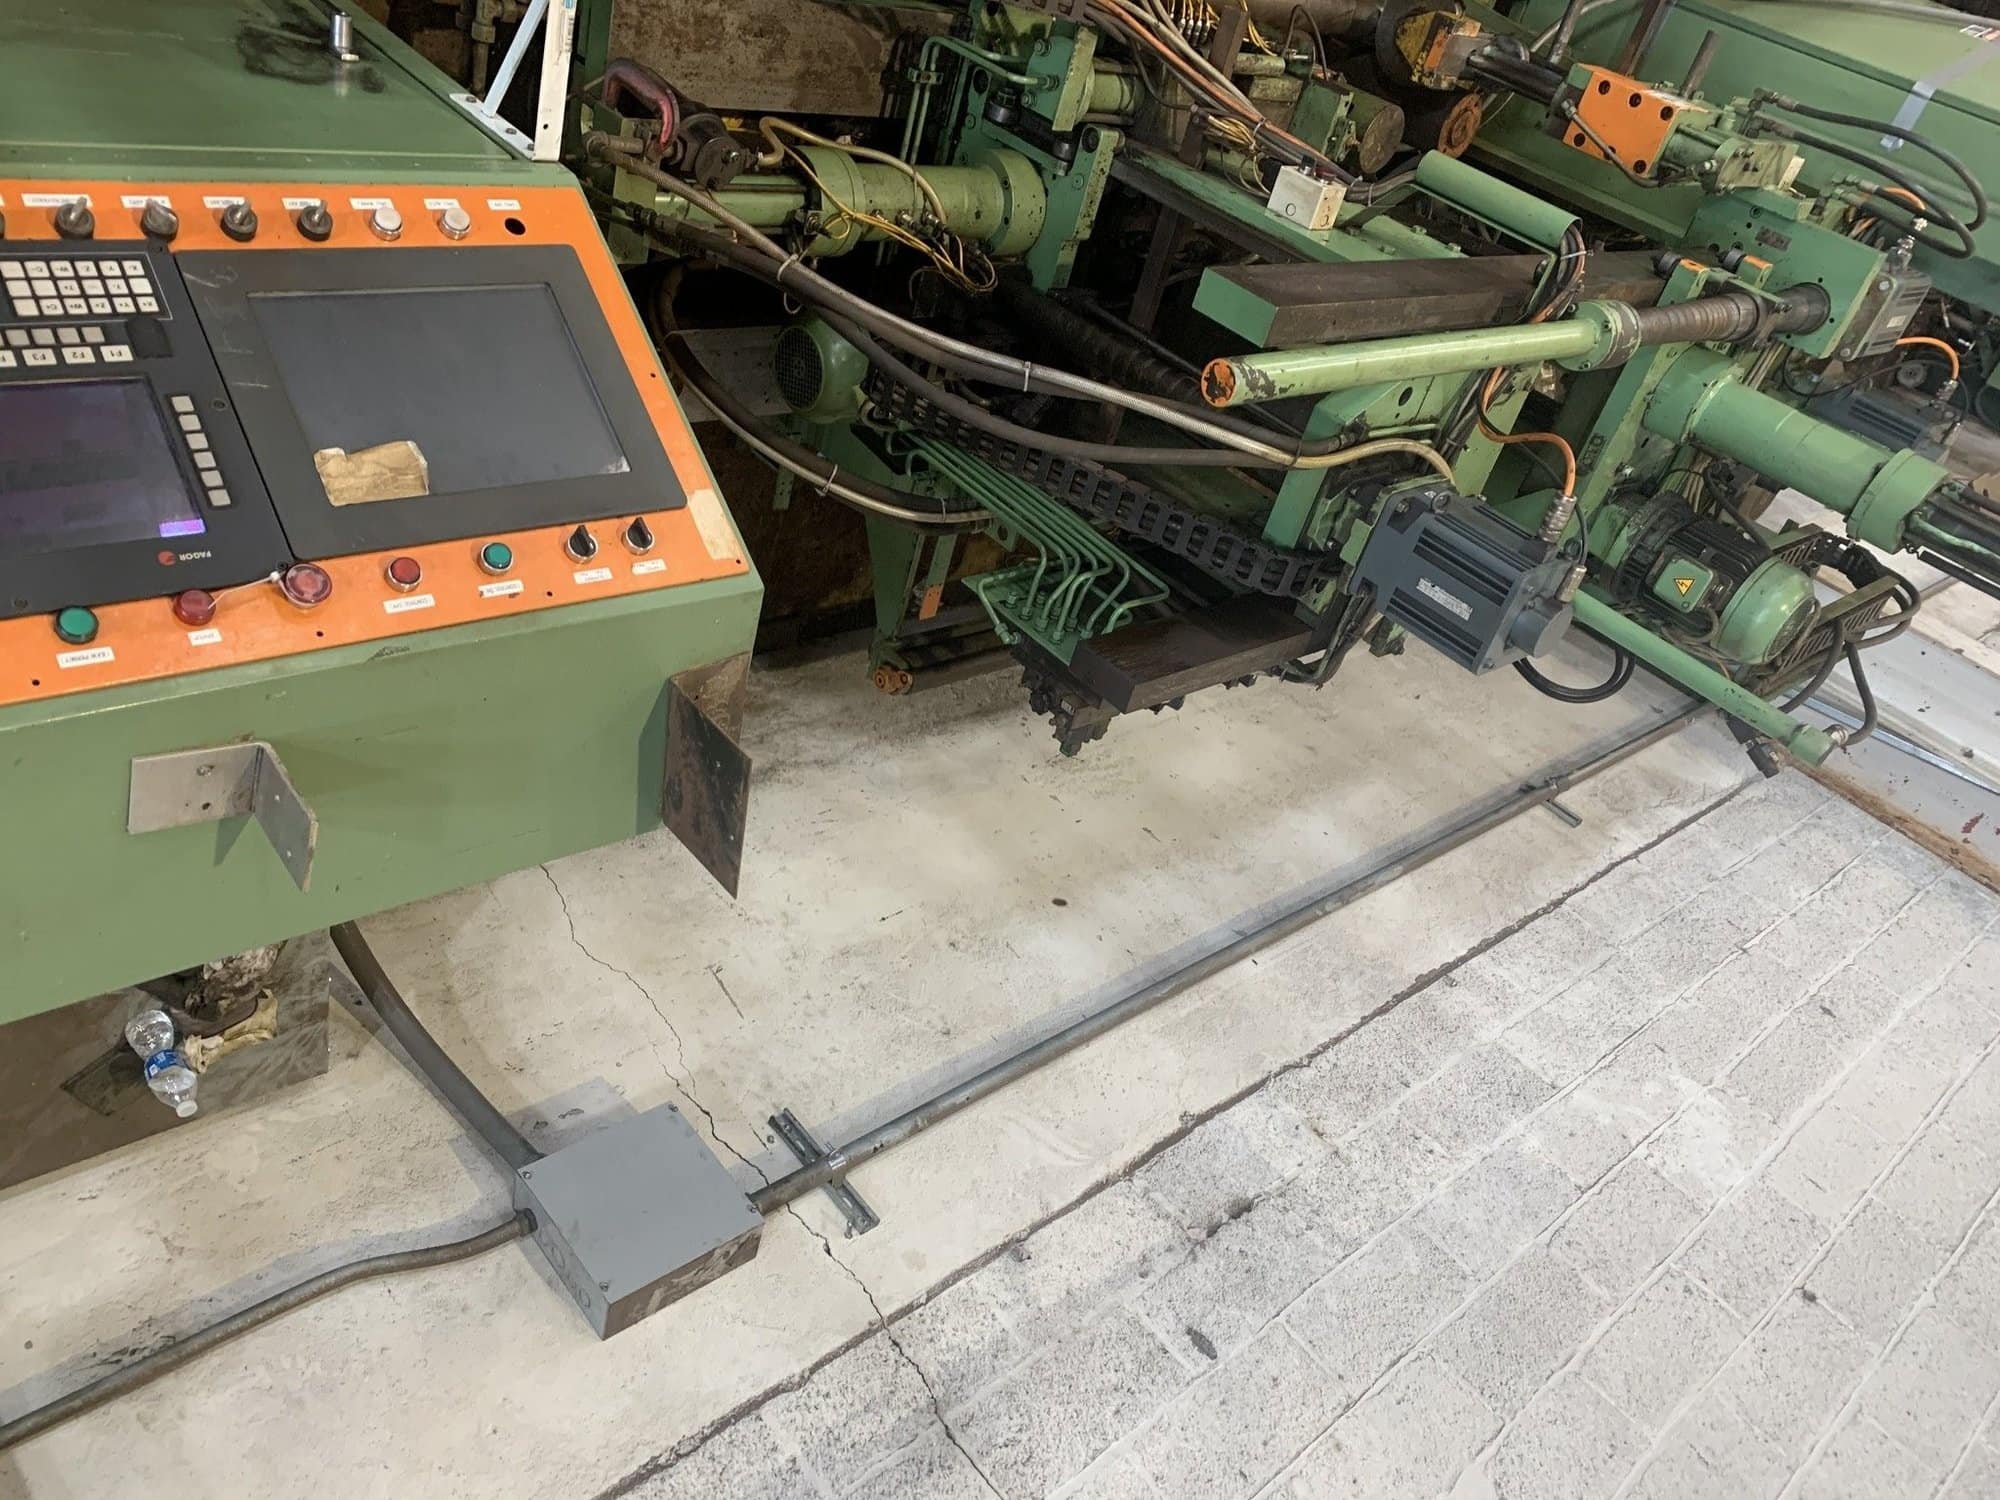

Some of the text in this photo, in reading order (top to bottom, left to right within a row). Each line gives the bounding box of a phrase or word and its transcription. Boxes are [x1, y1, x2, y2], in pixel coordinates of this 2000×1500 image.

[32, 353, 46, 361] F3
[72, 351, 85, 359] F2
[179, 550, 211, 560] FAGOR
